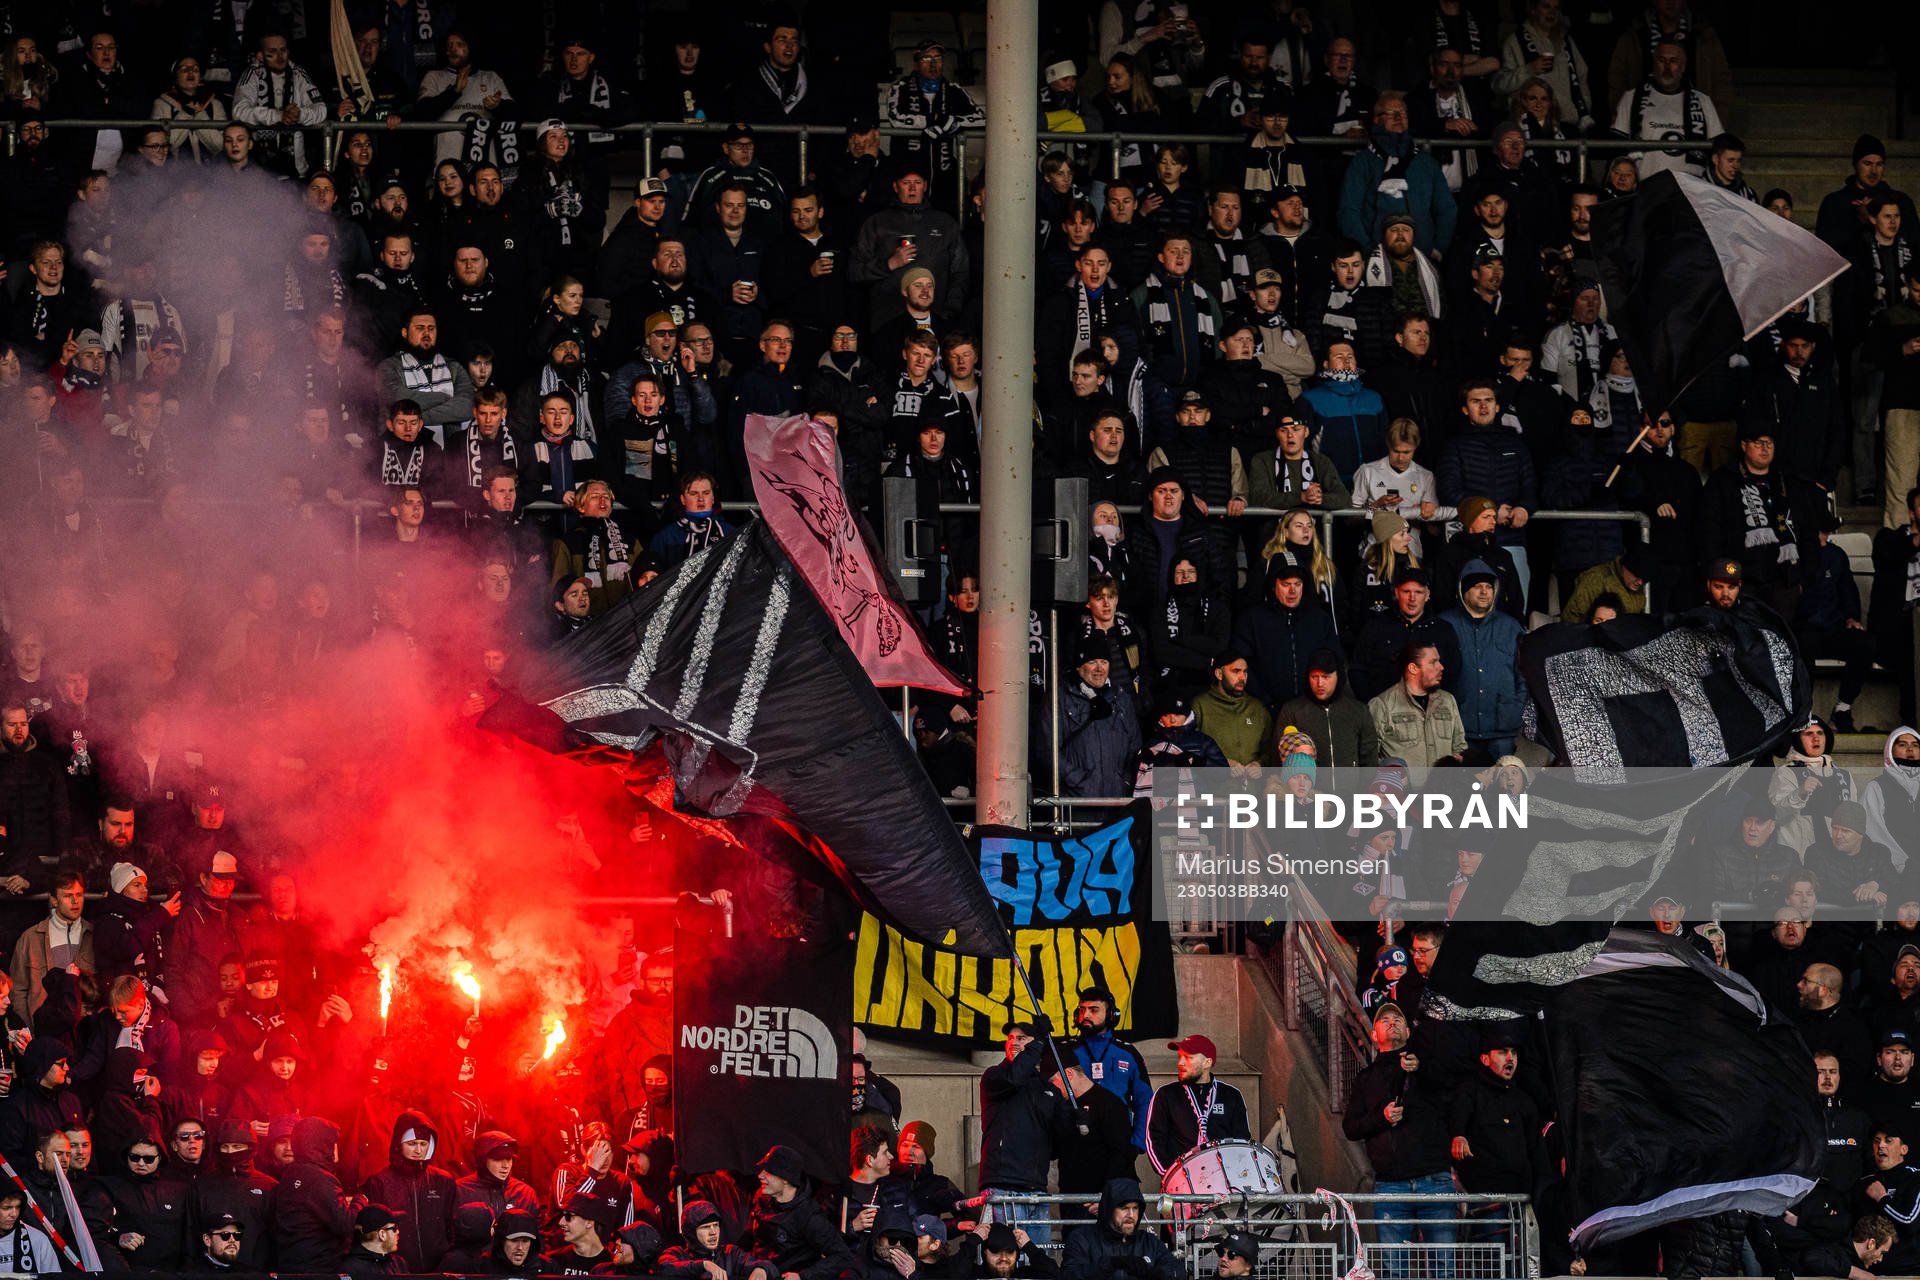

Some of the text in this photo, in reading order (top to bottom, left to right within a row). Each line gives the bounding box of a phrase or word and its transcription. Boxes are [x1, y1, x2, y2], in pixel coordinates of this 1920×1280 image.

[735, 1005, 790, 1031] DET
[681, 1025, 786, 1052] NORDRE
[720, 1052, 787, 1078] FELT
